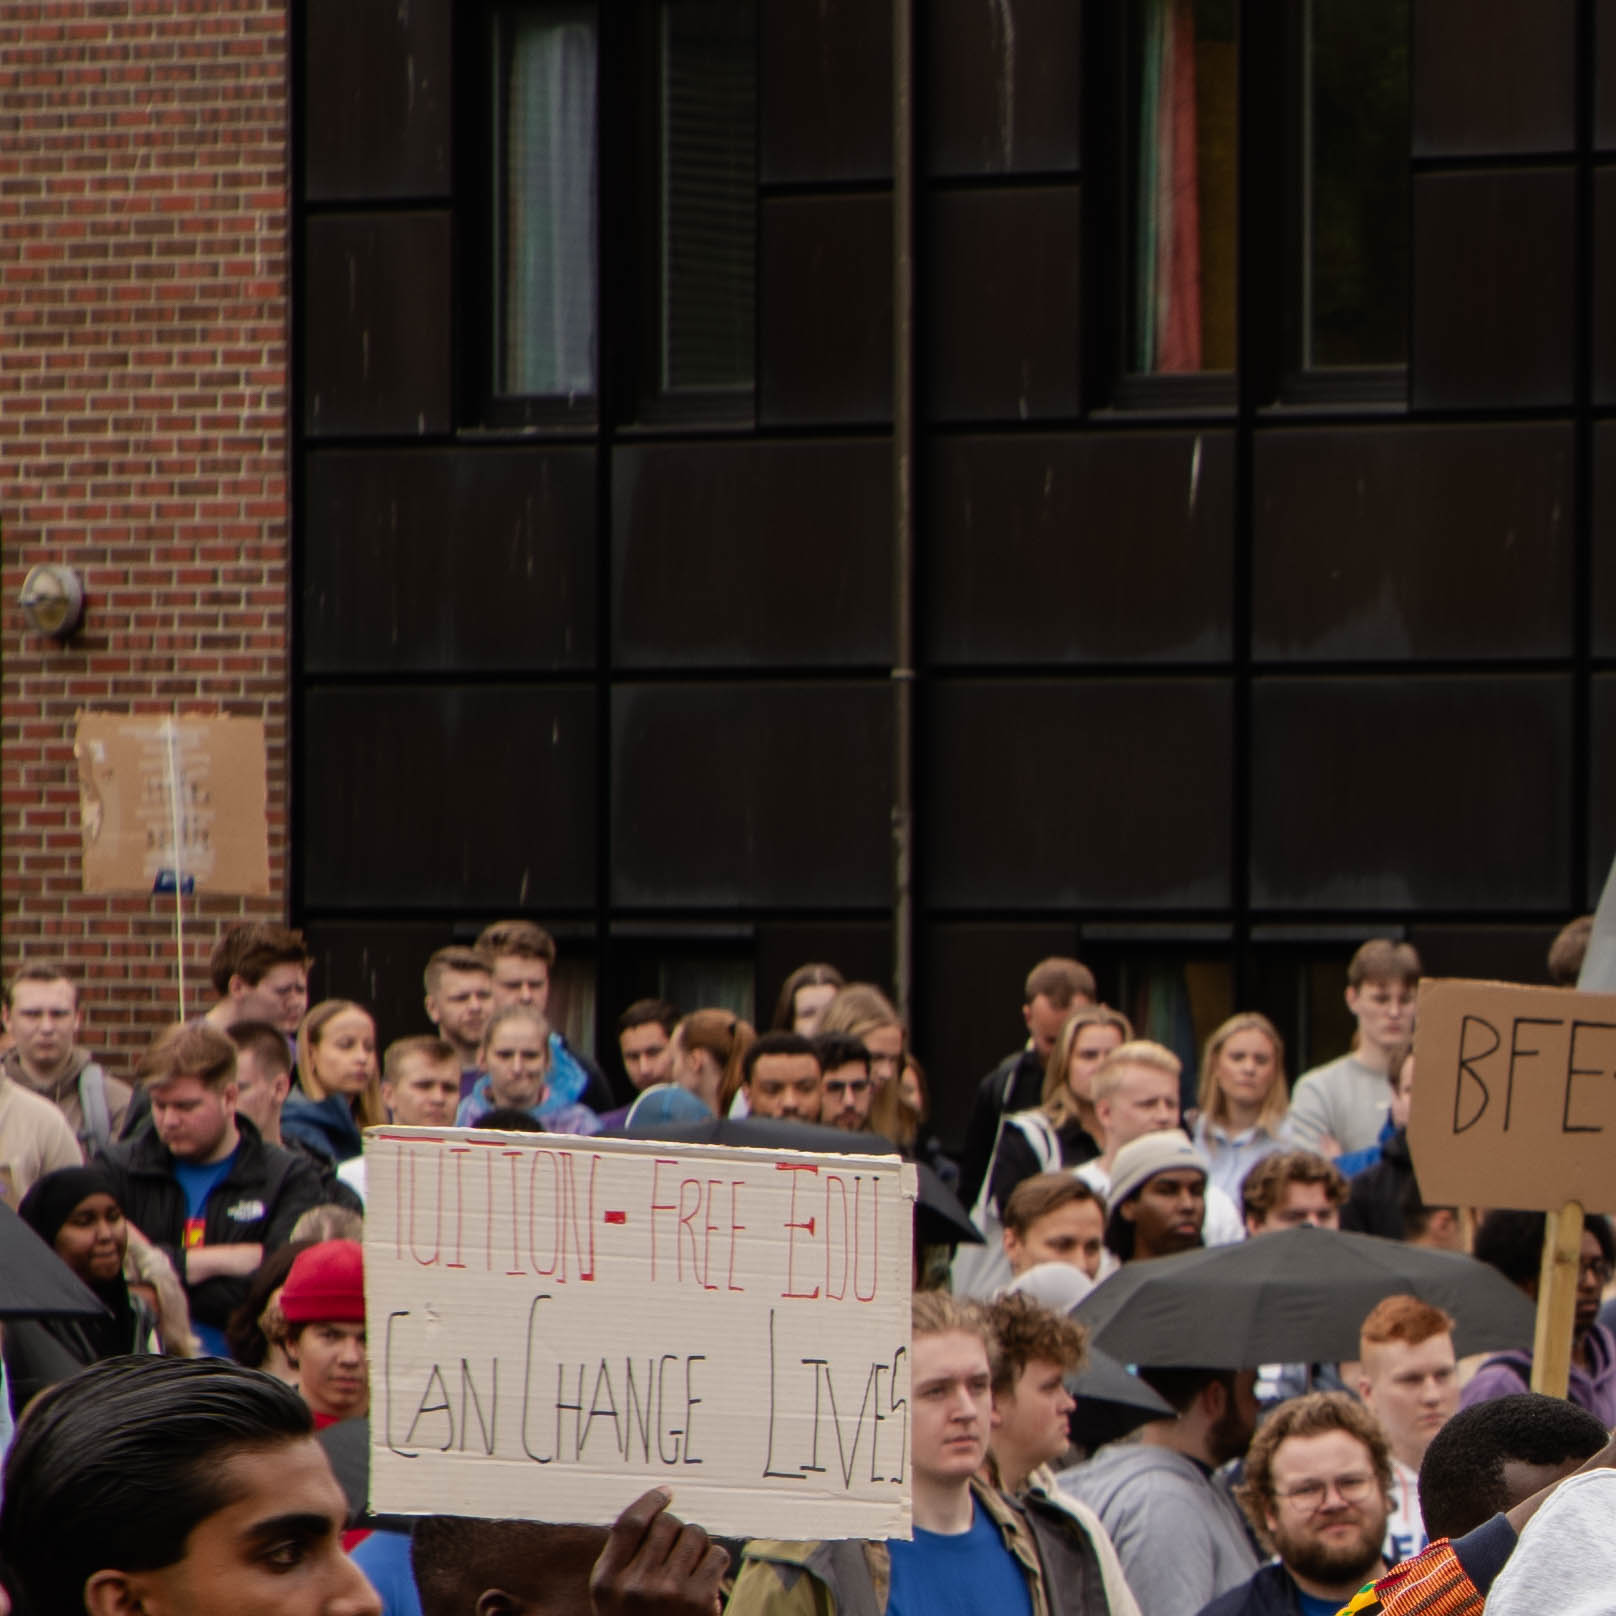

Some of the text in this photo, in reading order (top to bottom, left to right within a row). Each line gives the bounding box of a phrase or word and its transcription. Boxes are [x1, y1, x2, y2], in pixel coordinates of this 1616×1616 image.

[775, 1161, 880, 1302] EDU
[385, 1293, 907, 1490] CAN CHANGE LIVES
